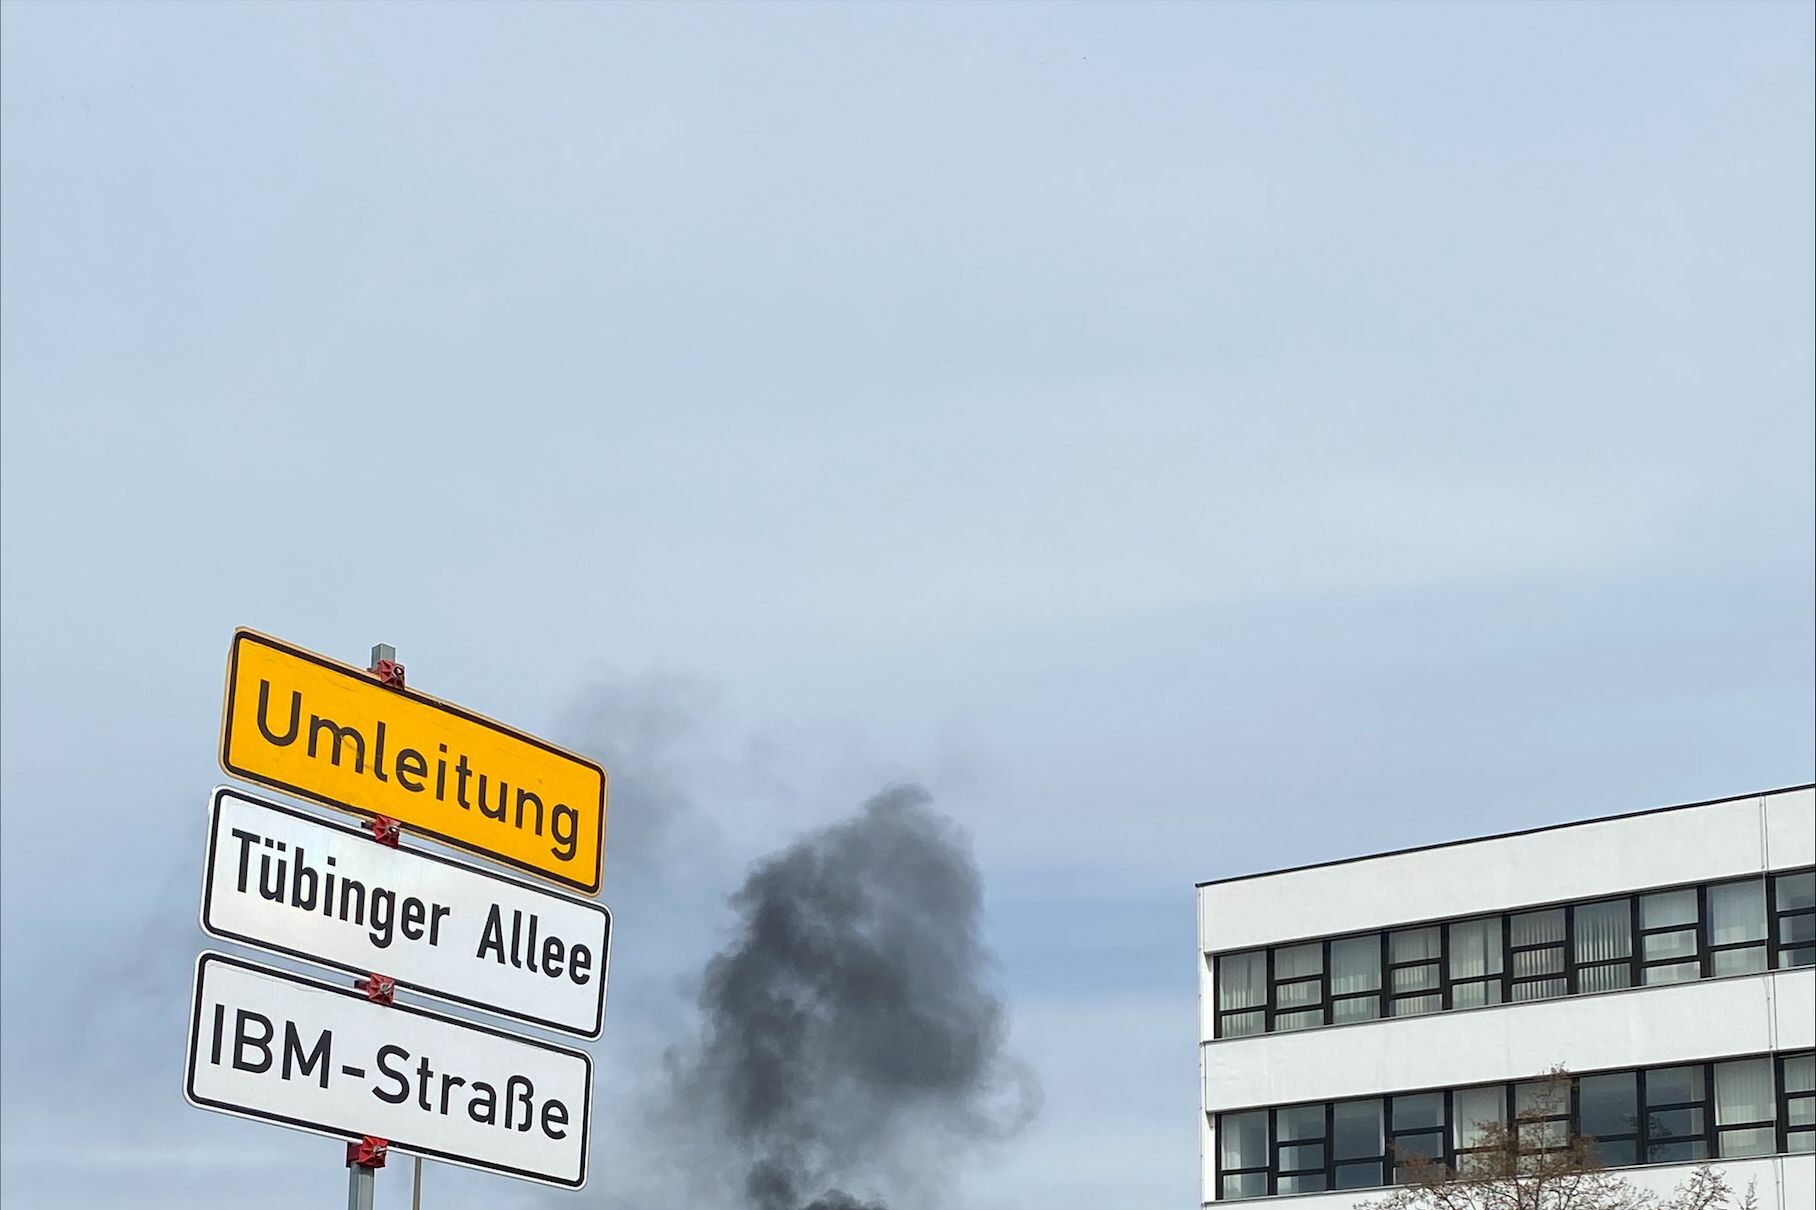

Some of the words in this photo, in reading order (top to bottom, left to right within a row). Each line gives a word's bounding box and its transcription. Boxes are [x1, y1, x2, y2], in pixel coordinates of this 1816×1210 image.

[256, 678, 579, 862] Umleitung
[231, 827, 451, 949] Tübinger
[476, 903, 593, 985] Allee
[210, 1003, 569, 1140] IBM-Straße
